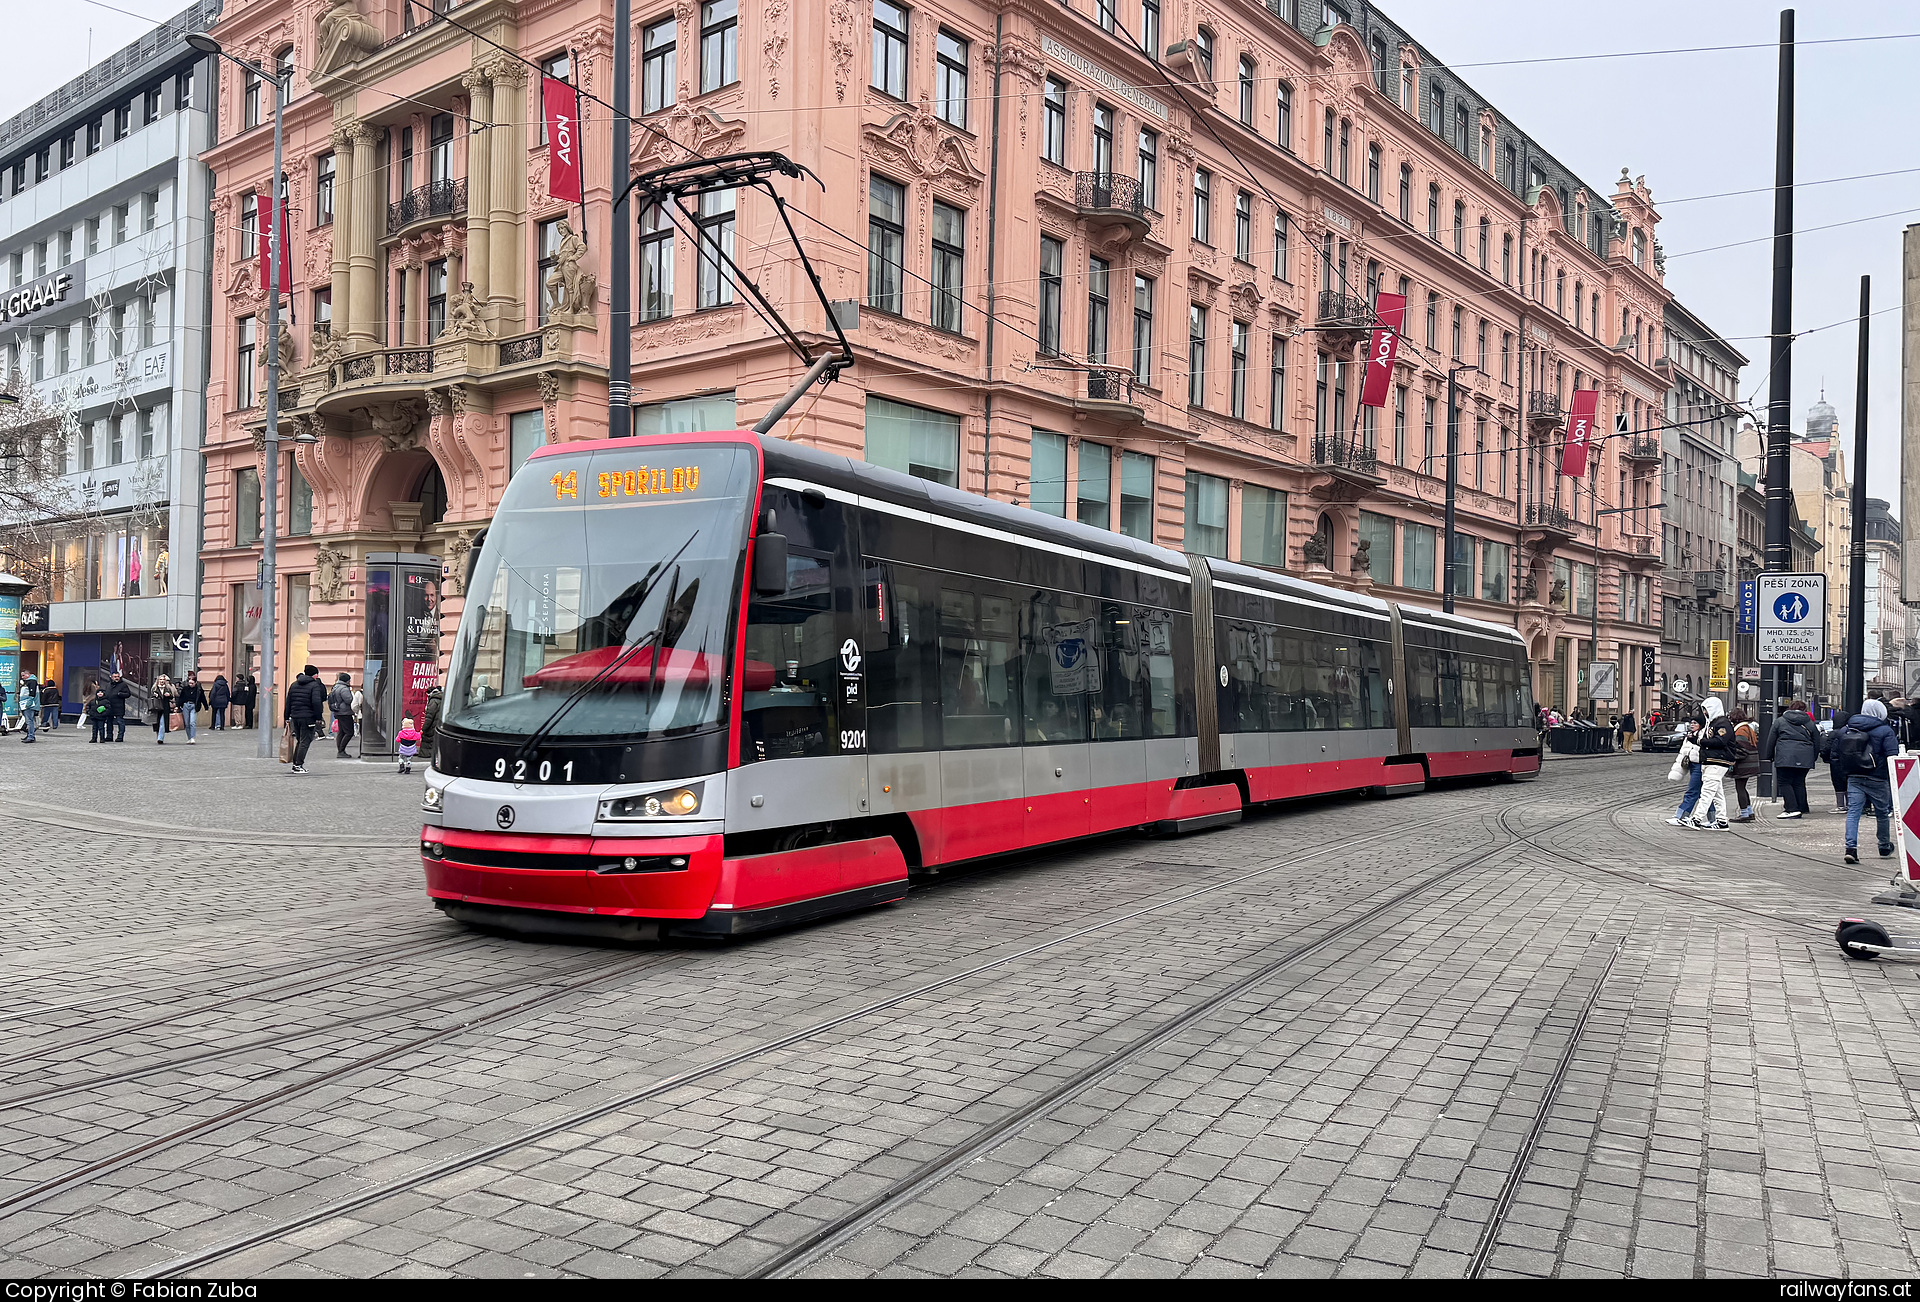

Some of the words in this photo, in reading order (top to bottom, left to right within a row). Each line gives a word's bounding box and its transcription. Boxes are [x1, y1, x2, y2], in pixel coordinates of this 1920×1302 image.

[1046, 40, 1118, 91] ASSICURAZIONI
[1121, 83, 1163, 117] GENERALI
[556, 114, 571, 166] AON
[7, 273, 67, 318] GRAAF
[1375, 330, 1394, 368] AON
[1571, 418, 1588, 448] AON
[550, 469, 578, 500] 14
[598, 465, 700, 498] SPOŘILOV
[542, 573, 550, 622] SEPHORA
[1764, 577, 1788, 589] PĚŠÍ
[1791, 577, 1819, 588] ZÓNA
[1768, 652, 1779, 660] MČ
[846, 682, 858, 697] pid
[841, 729, 866, 750] 9201
[493, 757, 574, 783] 9201
